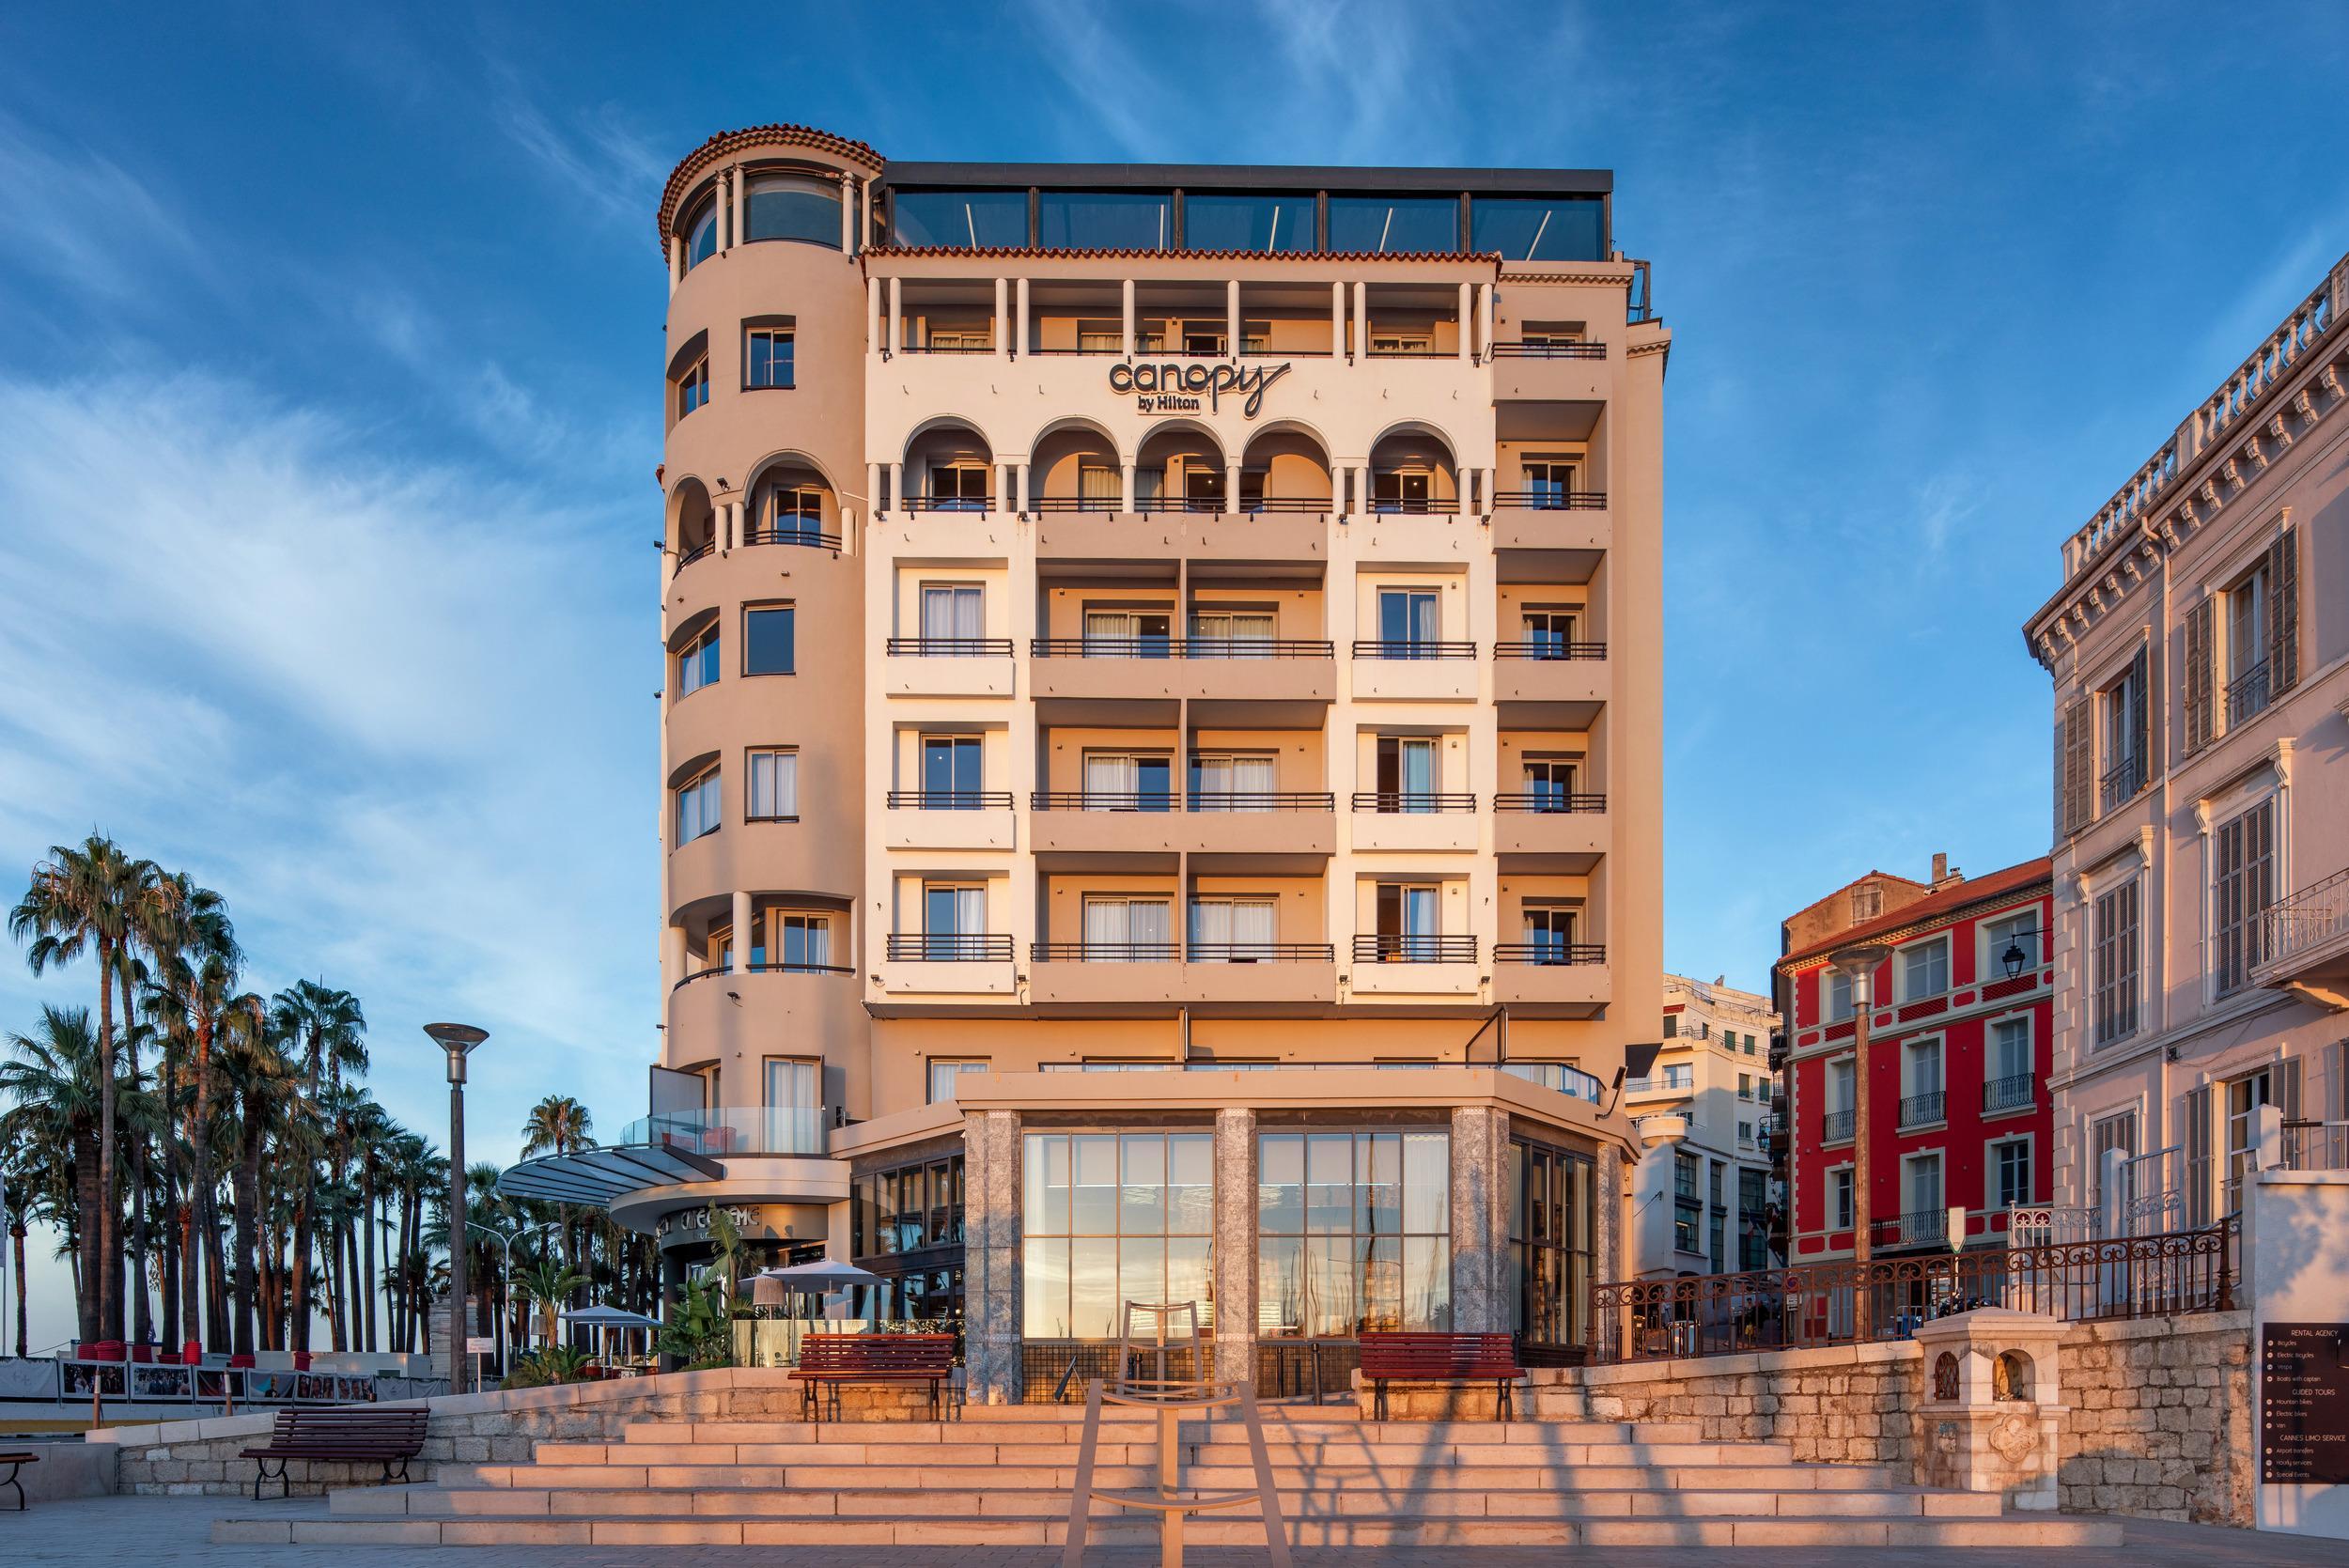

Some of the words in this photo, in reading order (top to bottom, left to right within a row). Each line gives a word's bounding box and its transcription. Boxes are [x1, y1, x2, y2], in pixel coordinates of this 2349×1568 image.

[1109, 362, 1290, 418] canopy
[1137, 396, 1154, 412] by
[1157, 396, 1200, 410] Hilton
